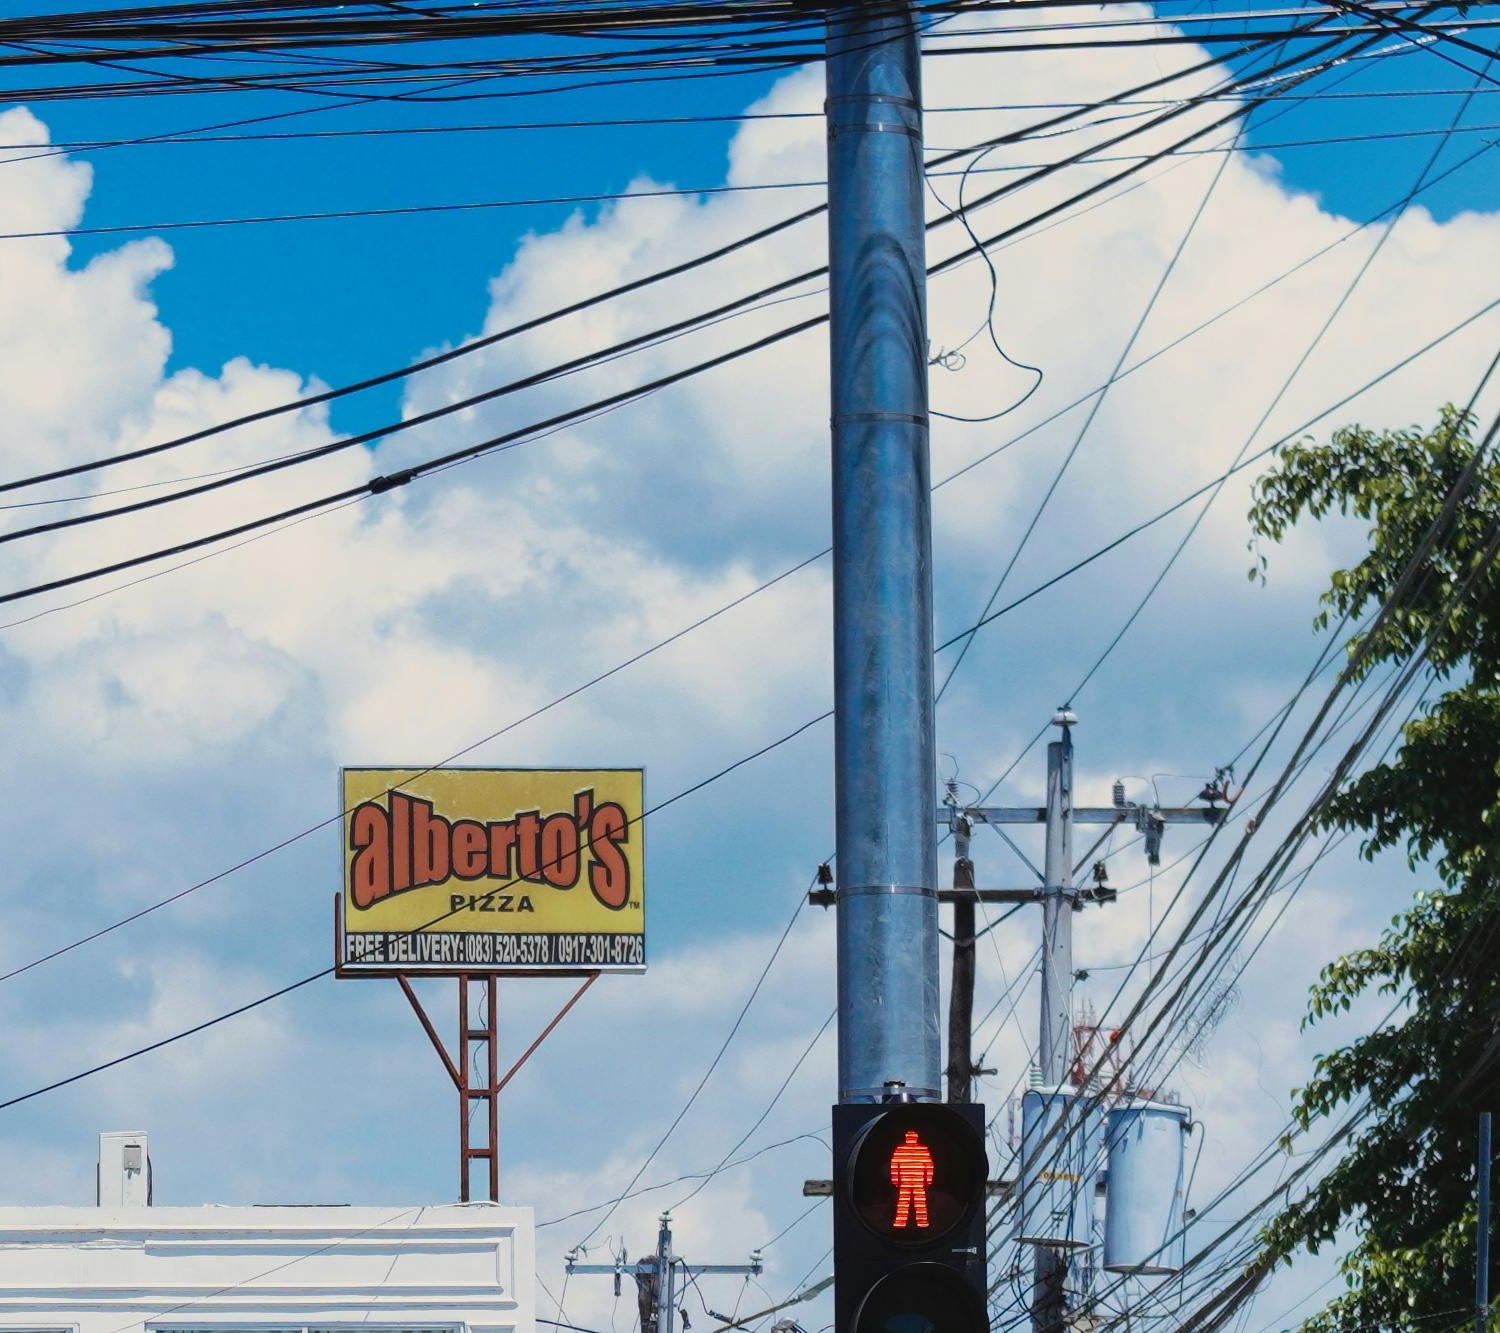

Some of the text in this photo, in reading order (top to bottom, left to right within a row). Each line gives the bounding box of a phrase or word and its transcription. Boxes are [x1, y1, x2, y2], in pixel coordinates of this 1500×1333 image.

[350, 788, 630, 911] alberto's
[450, 895, 535, 913] PIZZA
[346, 935, 384, 963] FREE
[465, 935, 494, 963] (083)
[496, 935, 549, 963] 520-5378
[558, 935, 643, 963] 0917-301-8726
